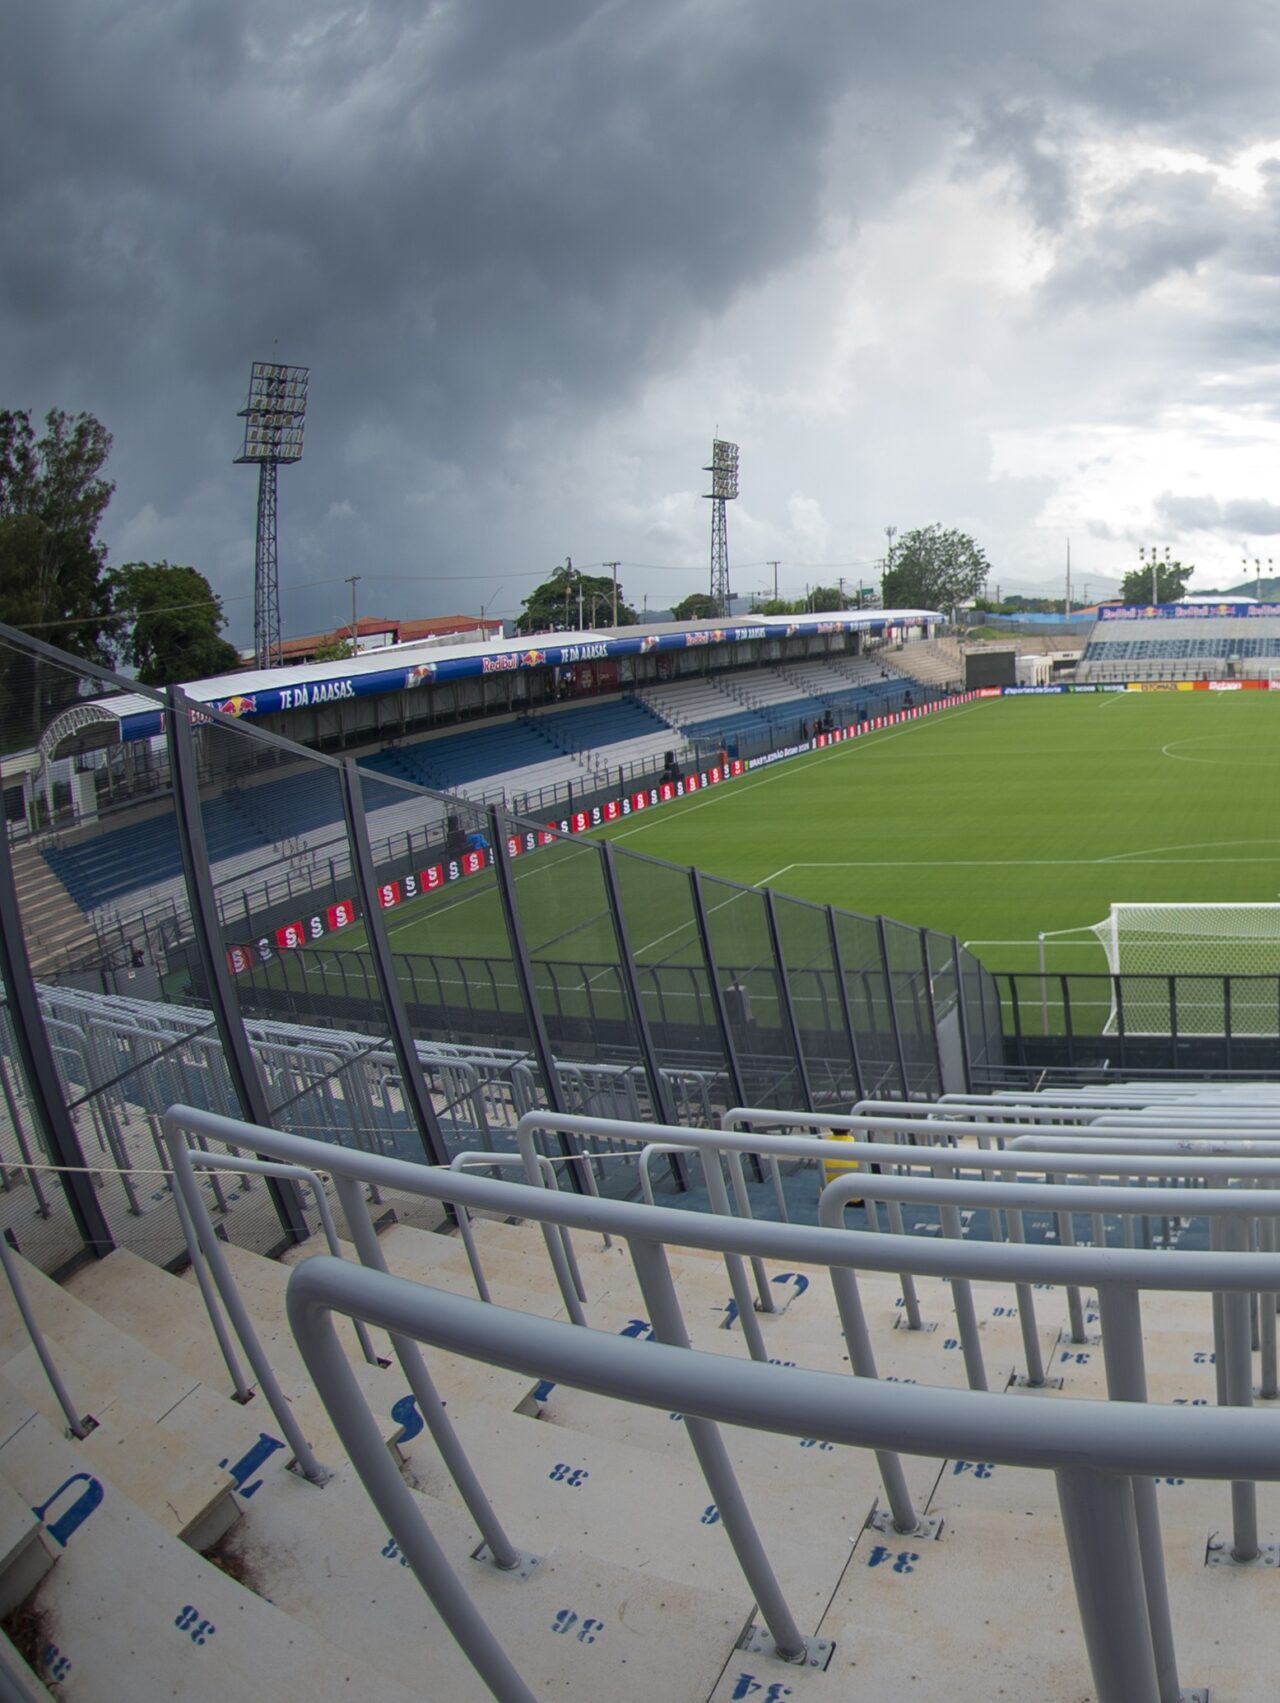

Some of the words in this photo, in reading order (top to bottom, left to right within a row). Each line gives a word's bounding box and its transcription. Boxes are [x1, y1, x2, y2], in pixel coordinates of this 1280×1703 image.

[482, 657, 500, 673] Red
[500, 653, 517, 670] Bull
[279, 690, 292, 710] TE
[1060, 1351, 1091, 1365] 34
[220, 1432, 286, 1500] T
[548, 1462, 590, 1488] 38
[32, 1472, 104, 1547] U
[867, 1545, 920, 1574] 34
[174, 1604, 216, 1647] 38
[550, 1608, 605, 1644] 36
